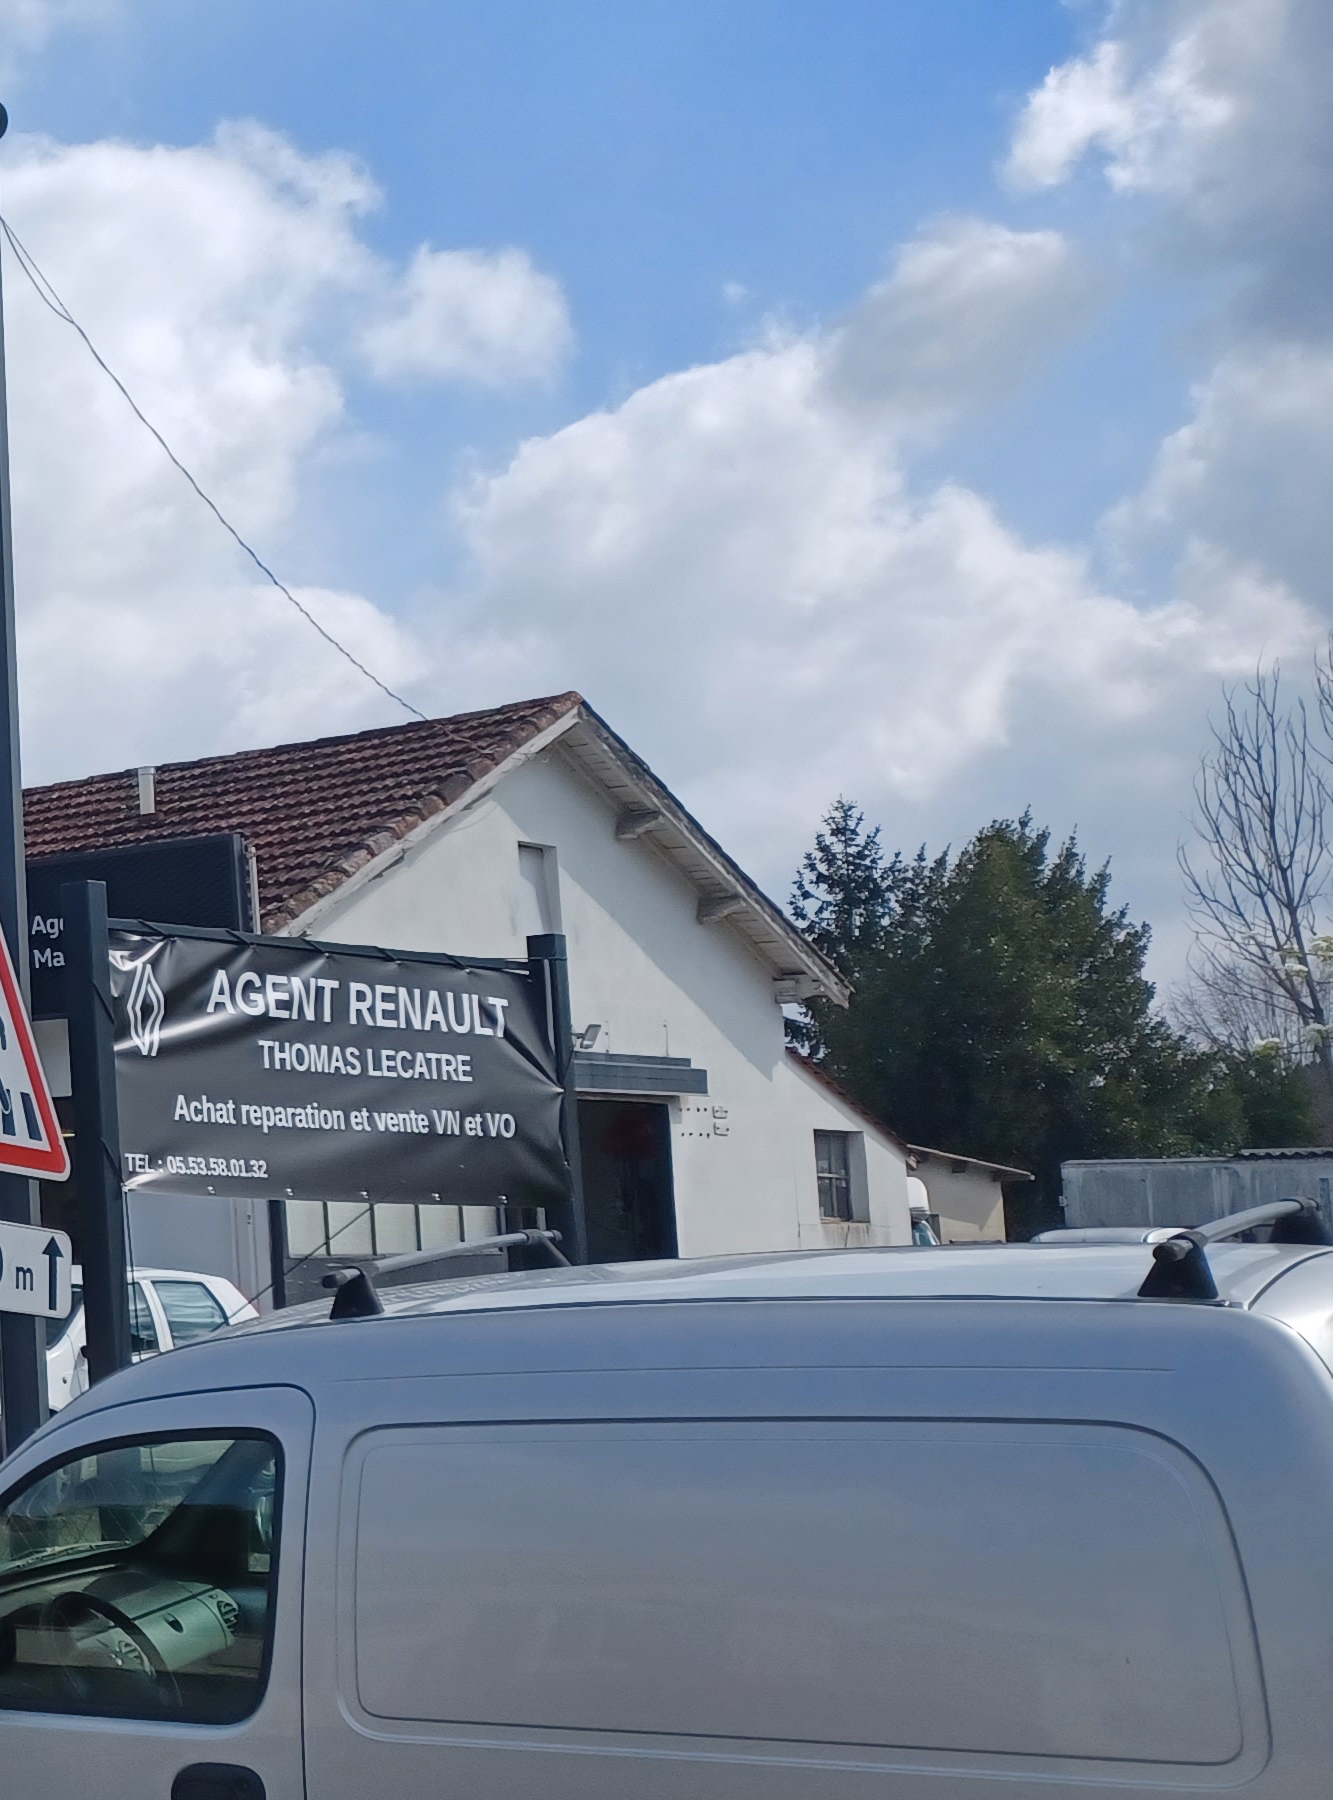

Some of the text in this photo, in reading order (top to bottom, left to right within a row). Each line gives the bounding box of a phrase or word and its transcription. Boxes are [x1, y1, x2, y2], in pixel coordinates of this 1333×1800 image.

[32, 915, 64, 939] Ag
[207, 969, 509, 1038] AGENT RENAULT
[258, 1040, 473, 1082] THOMAS LECATRE
[174, 1095, 516, 1138] Achat reparation et vente VN et VO
[125, 1153, 155, 1173] TEL
[166, 1155, 268, 1178] 05.53.58.01.32
[15, 1266, 34, 1291] m
